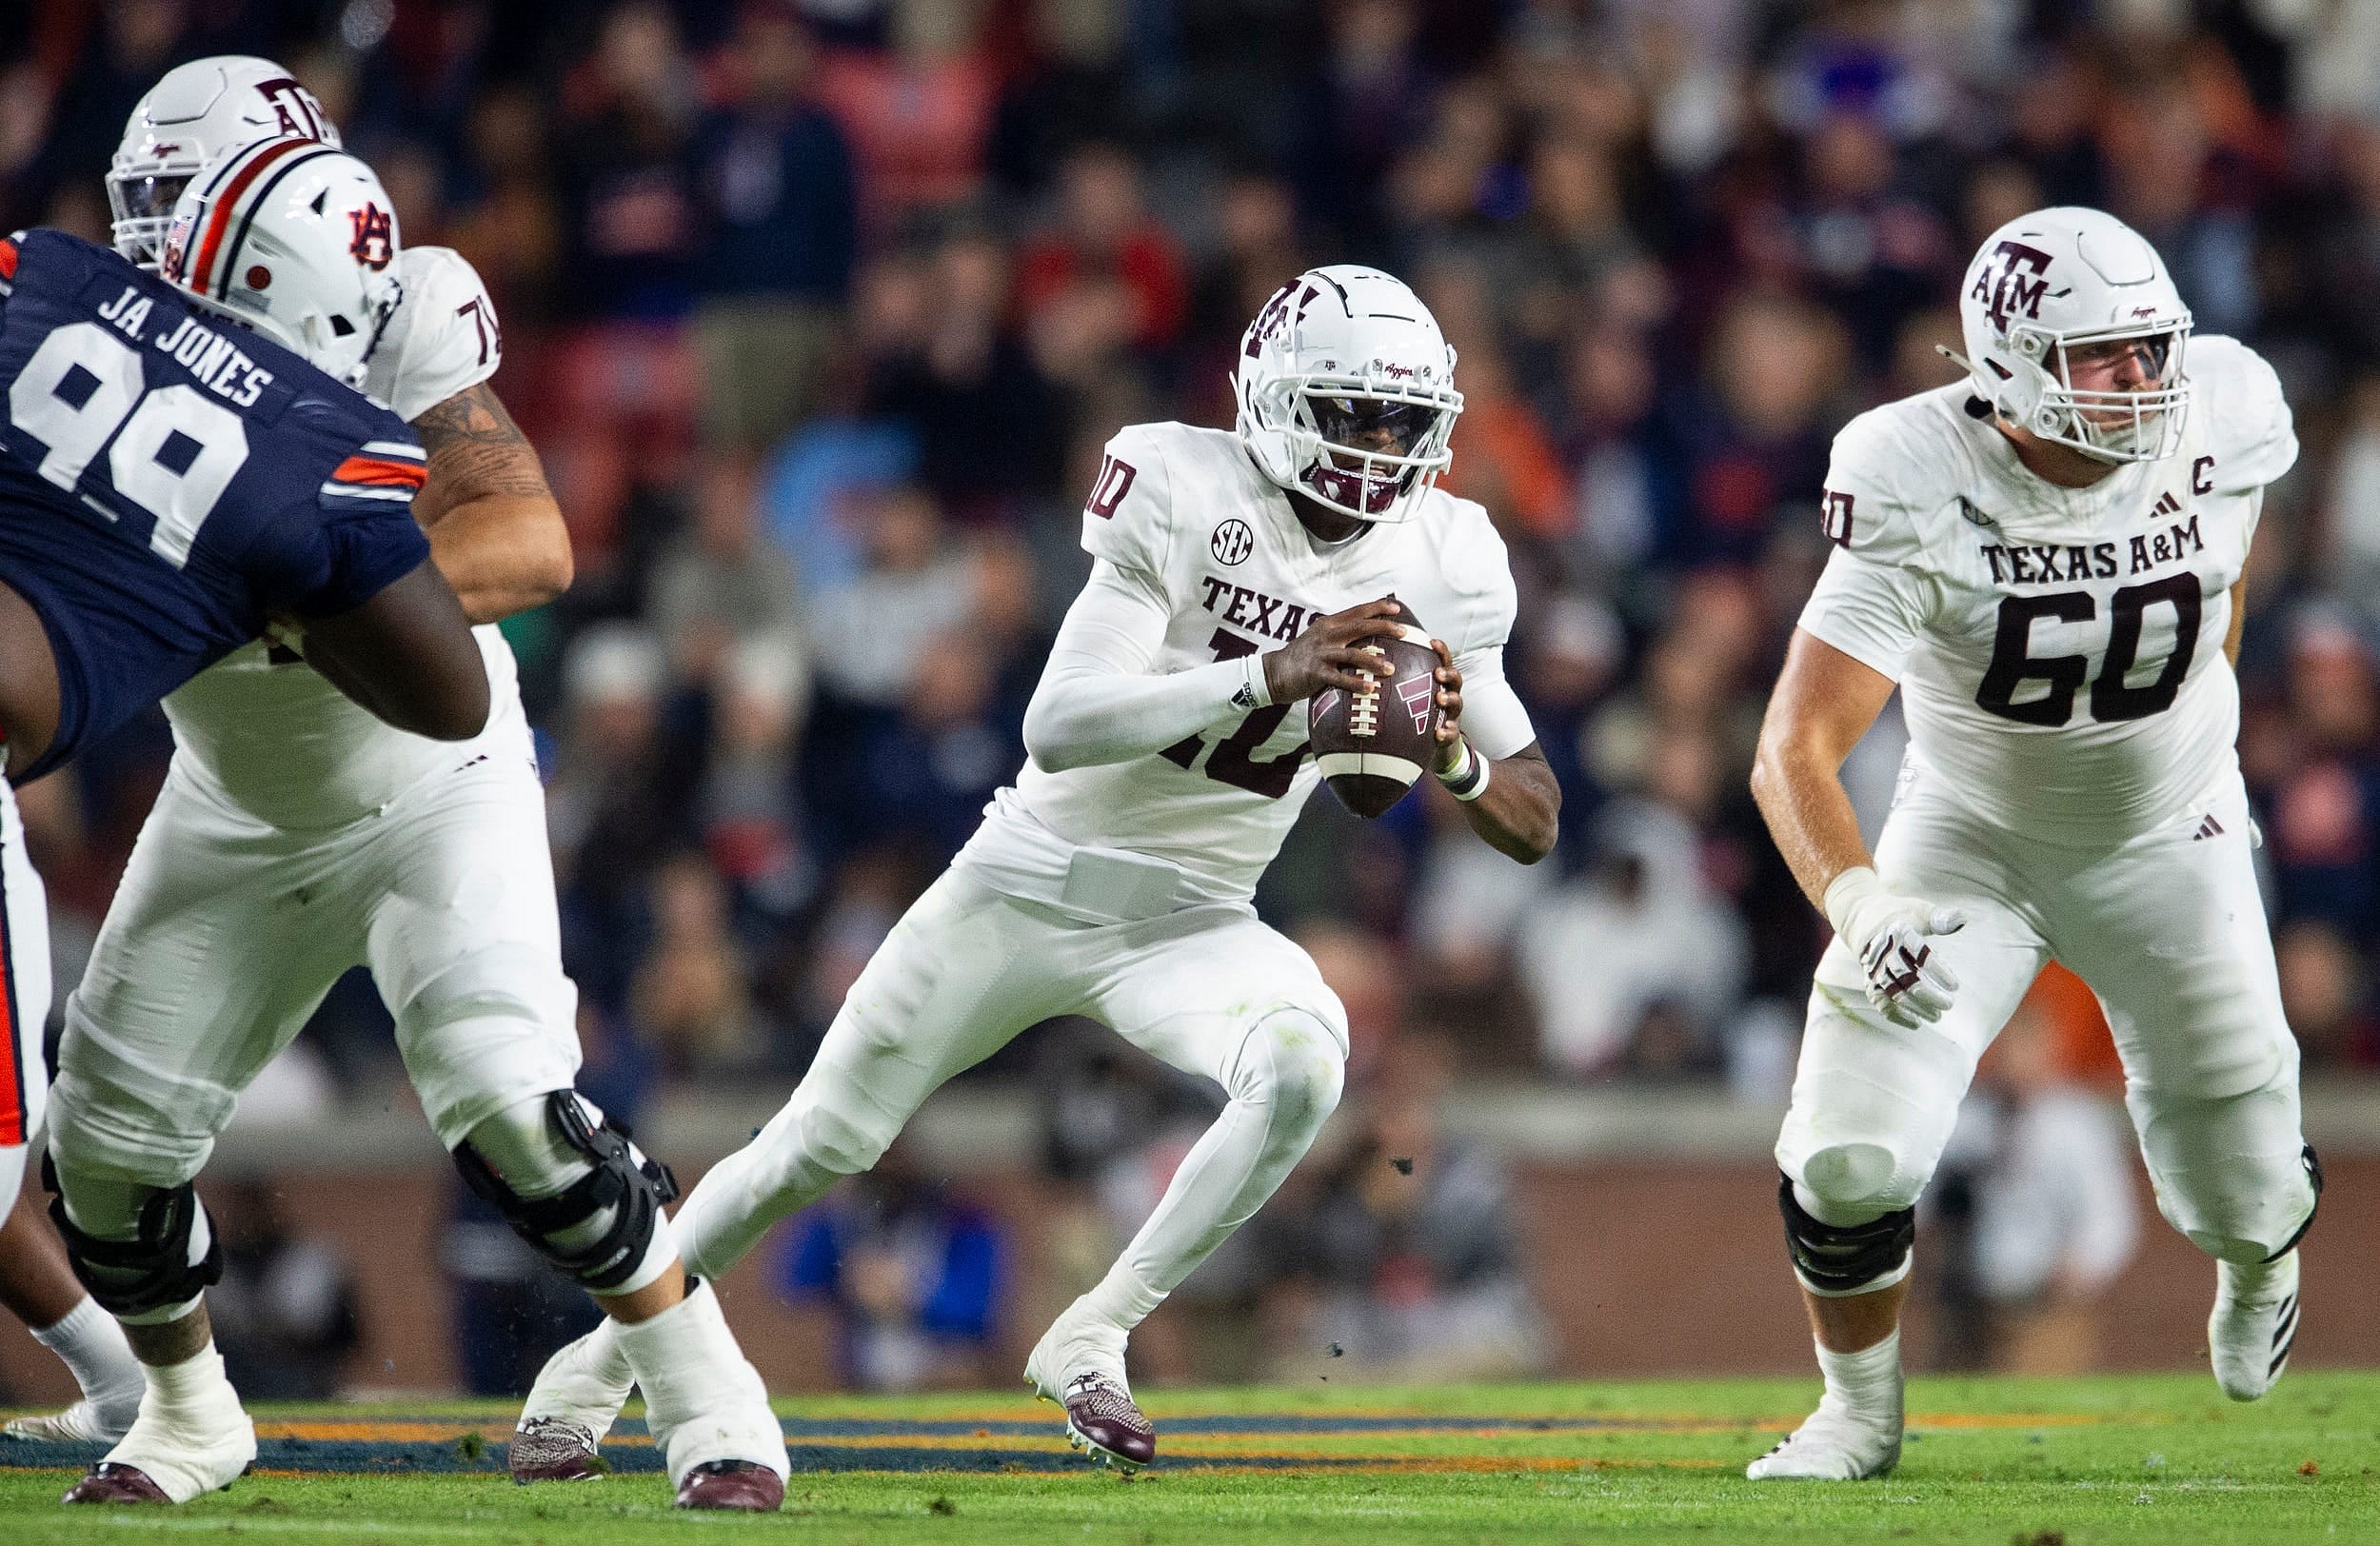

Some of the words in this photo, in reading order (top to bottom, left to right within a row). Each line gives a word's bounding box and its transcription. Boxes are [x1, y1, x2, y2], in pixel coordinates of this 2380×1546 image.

[155, 318, 274, 407] JONES
[1384, 363, 1413, 380] Aggies
[9, 321, 250, 570] 99
[2192, 455, 2215, 496] C
[1086, 454, 1137, 520] 10
[1211, 519, 1253, 565] SEC
[1980, 543, 2118, 585] TEXAS
[2130, 514, 2204, 575] A&M
[1201, 576, 1325, 644] TEXA
[1975, 571, 2201, 727] 60
